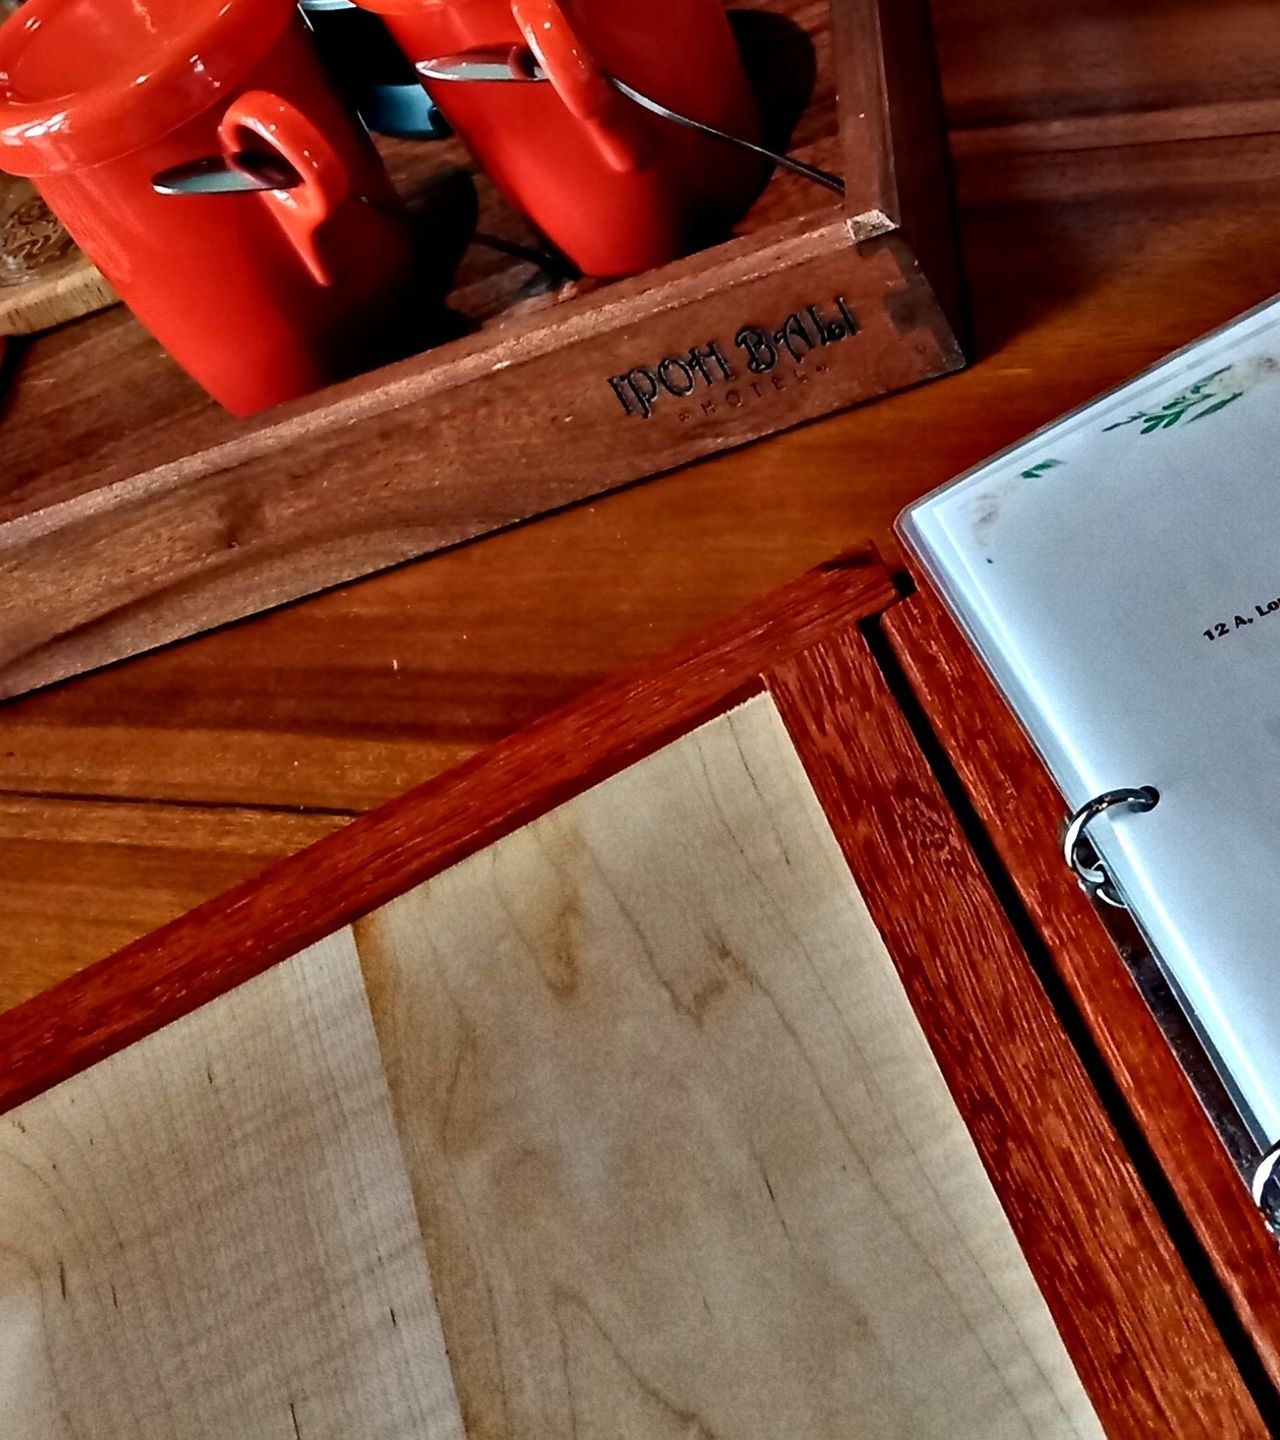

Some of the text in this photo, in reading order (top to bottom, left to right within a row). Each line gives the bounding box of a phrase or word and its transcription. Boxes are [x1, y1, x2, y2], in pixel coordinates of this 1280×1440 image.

[606, 297, 860, 420] IPOH BALI
[702, 368, 809, 417] HOTEL
[1203, 623, 1229, 640] 12
